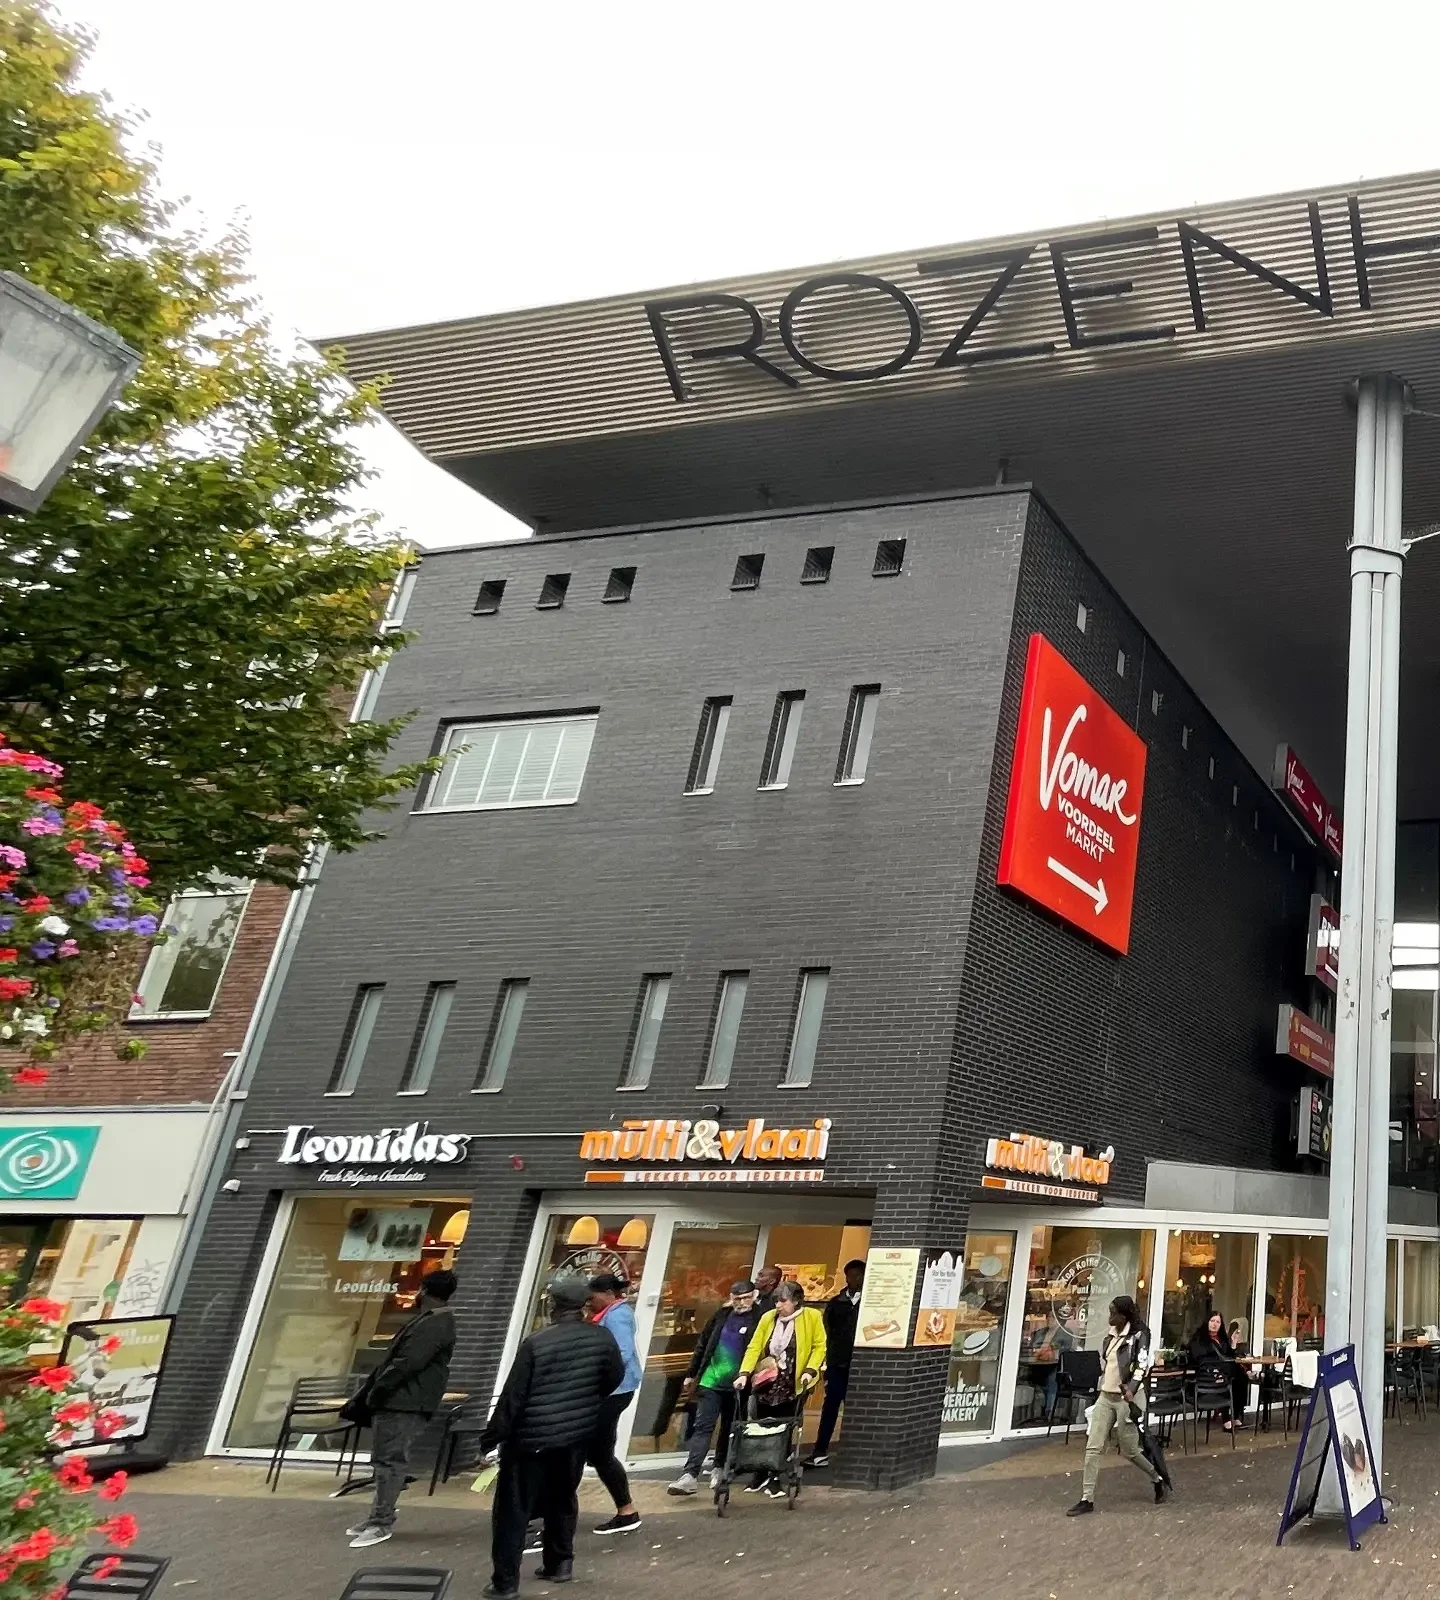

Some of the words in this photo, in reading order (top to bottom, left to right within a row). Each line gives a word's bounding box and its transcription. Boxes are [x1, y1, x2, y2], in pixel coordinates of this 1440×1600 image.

[1057, 792, 1116, 854] VOORDEEL
[1065, 821, 1105, 863] MARKT
[277, 1121, 472, 1164] Leonidas
[634, 1171, 690, 1182] LEKKER
[698, 1171, 738, 1182] VOOR
[746, 1170, 822, 1181] IEDEREEN
[1011, 1181, 1041, 1194] LEKKER
[1043, 1186, 1063, 1197] VOOR
[1075, 1257, 1099, 1271] Koffie
[333, 1278, 400, 1294] Leonidas
